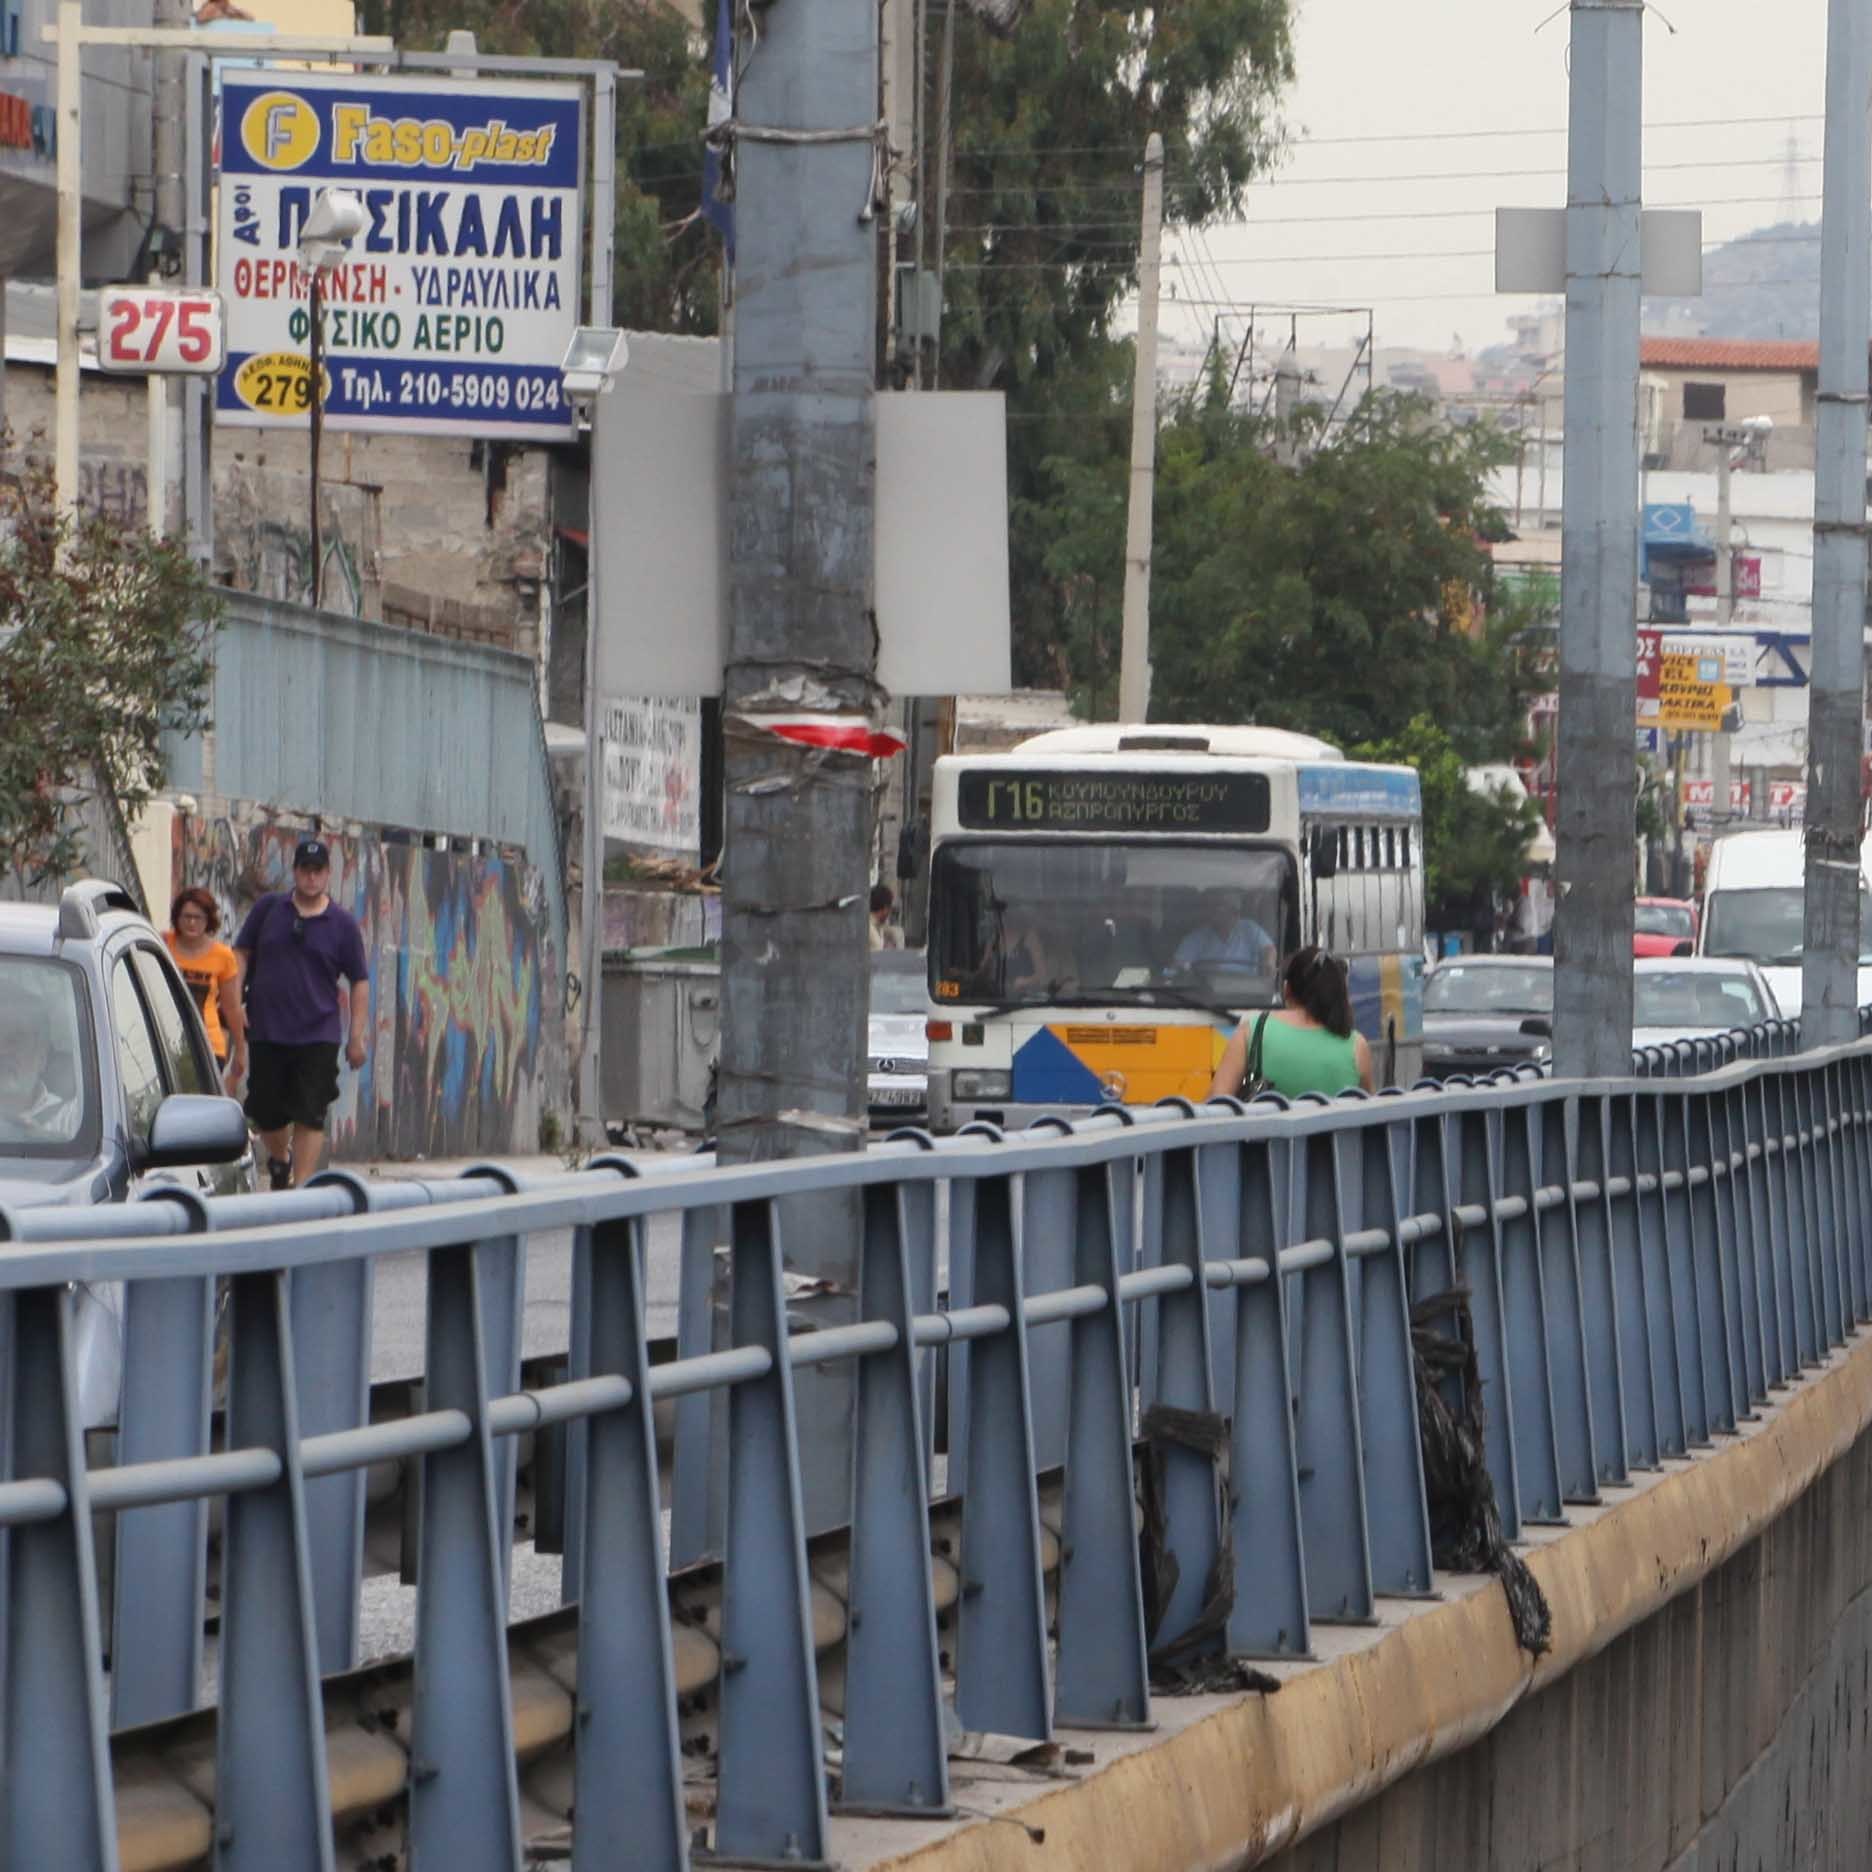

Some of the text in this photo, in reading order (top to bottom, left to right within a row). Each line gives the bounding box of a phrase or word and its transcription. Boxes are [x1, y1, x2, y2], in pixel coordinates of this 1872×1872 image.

[332, 103, 556, 171] Faso-plast
[278, 186, 562, 260] ΠΣΙΚΑΛΗ
[412, 266, 561, 311] ΥΔΡΑΥΛΙΚΑ
[109, 299, 213, 363] 275
[414, 312, 504, 353] ΑΕΡΙΟ
[256, 374, 312, 409] 279
[342, 368, 559, 410] Τηλ. 210-5909 024
[988, 780, 1044, 820] Γ16
